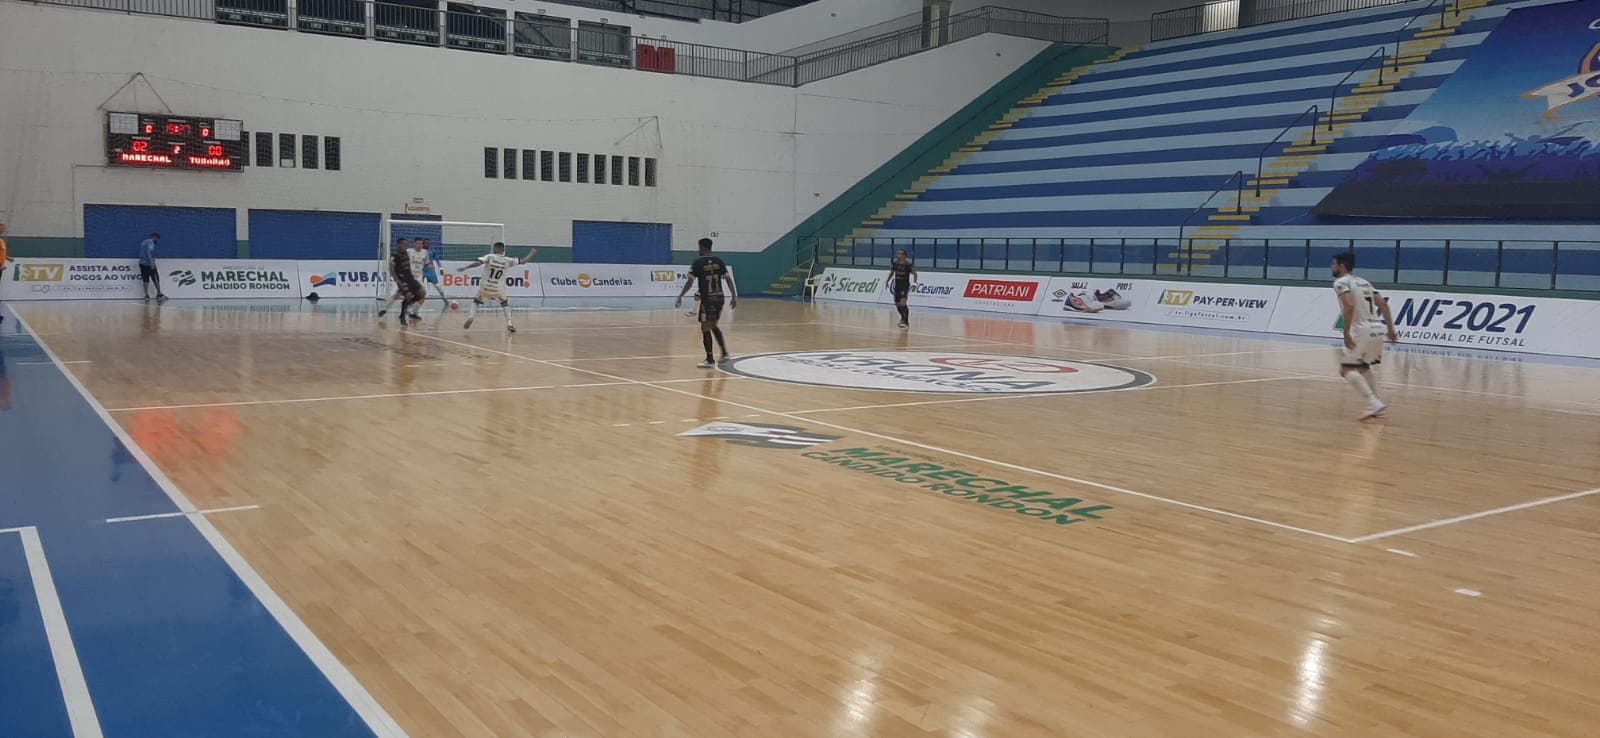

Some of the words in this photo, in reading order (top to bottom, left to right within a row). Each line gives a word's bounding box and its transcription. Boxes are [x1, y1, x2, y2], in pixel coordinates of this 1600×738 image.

[133, 141, 148, 151] 02
[122, 153, 172, 163] MARECHAL
[201, 271, 289, 282] MARECHAL
[489, 268, 503, 280] 10
[249, 282, 290, 290] RONDON
[551, 277, 577, 286] Clube
[593, 277, 633, 286] Candeias
[836, 277, 880, 294] Sicredi
[971, 283, 1030, 297] PATRIANI
[1193, 295, 1267, 309] PAY-PER-VIEW
[1397, 330, 1453, 342] NACIONAL
[1458, 334, 1473, 343] DE
[1478, 336, 1526, 347] FUTSAL
[801, 451, 924, 484] CANDIDO
[921, 482, 1085, 525] RONDON
[829, 447, 1115, 519] MARECHAL
